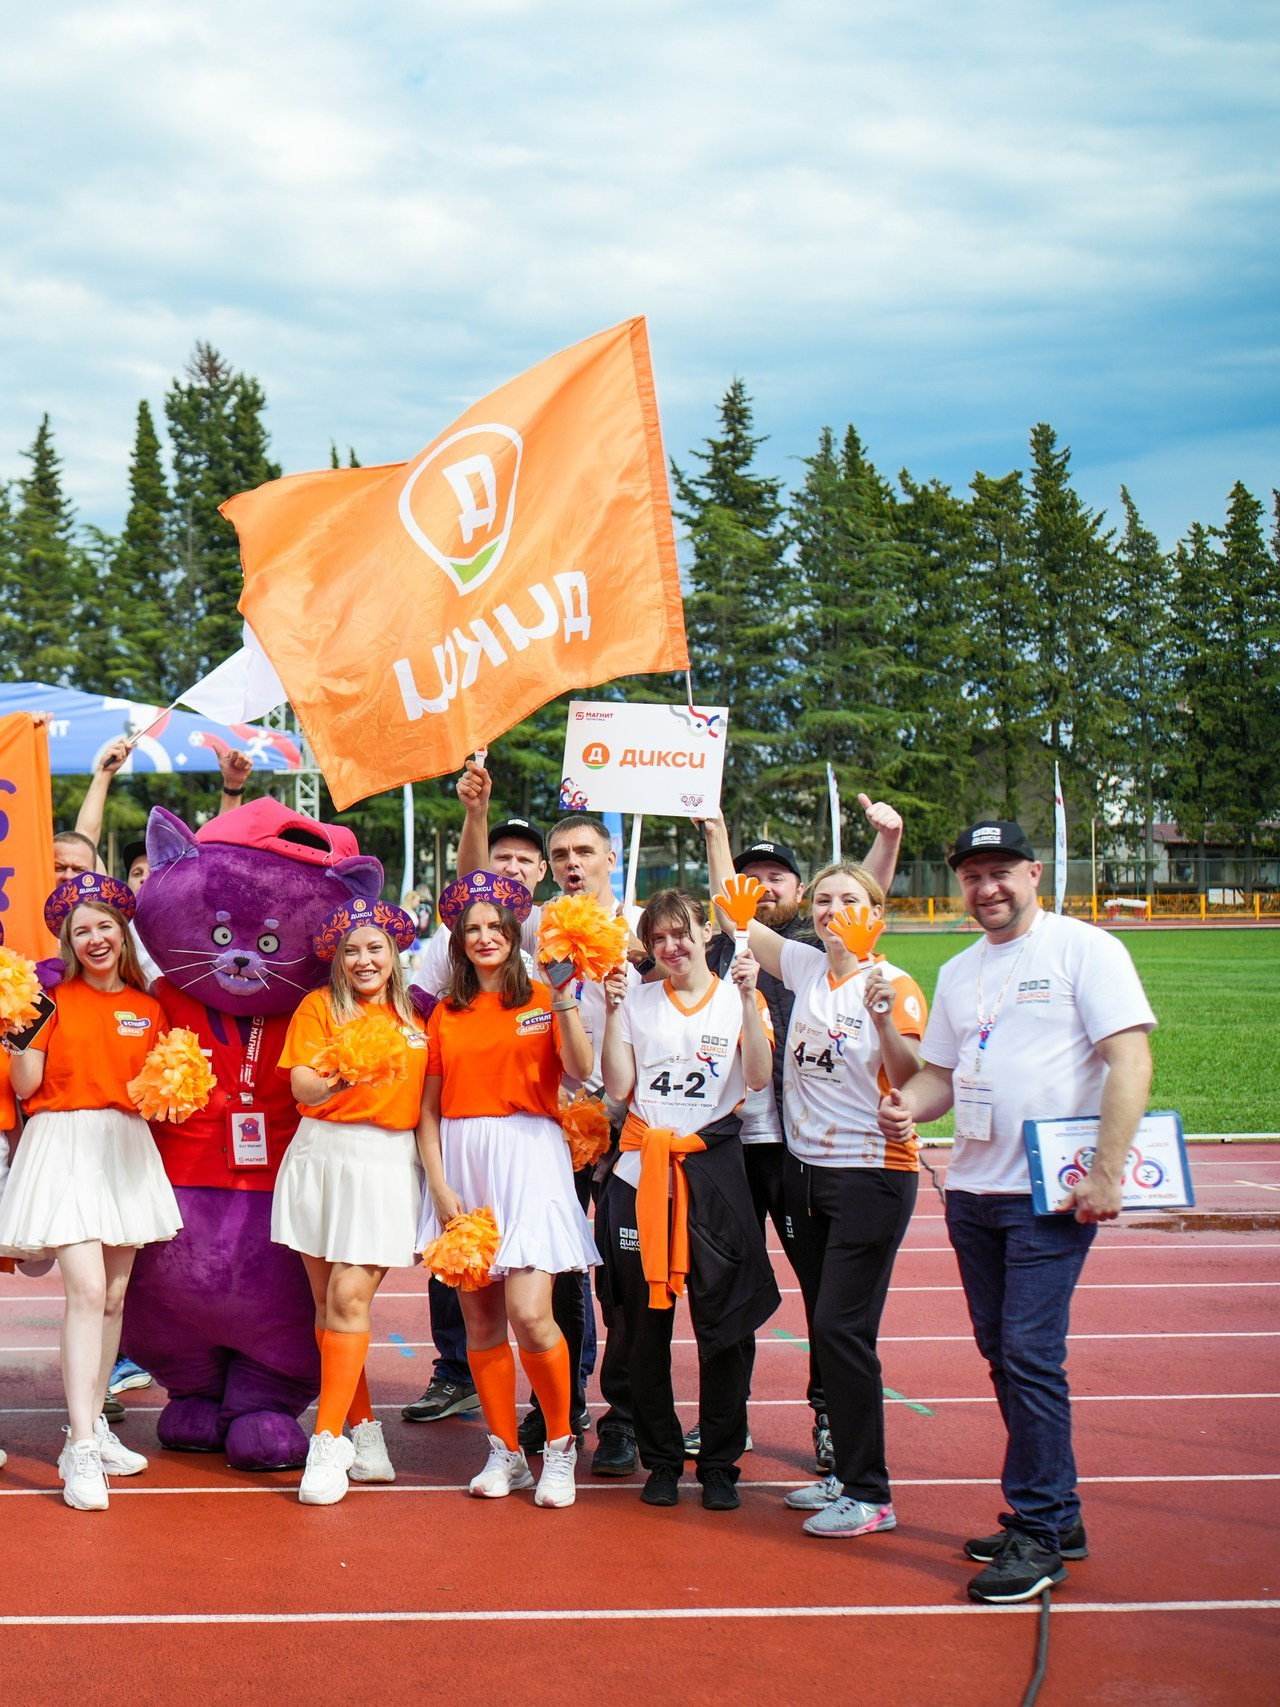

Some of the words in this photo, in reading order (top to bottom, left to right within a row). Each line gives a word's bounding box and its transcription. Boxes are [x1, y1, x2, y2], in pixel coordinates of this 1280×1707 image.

[588, 747, 604, 763] Д
[246, 1027, 259, 1062] МАГНИТ
[793, 1041, 835, 1073] 4-4
[649, 1071, 706, 1099] 4-2
